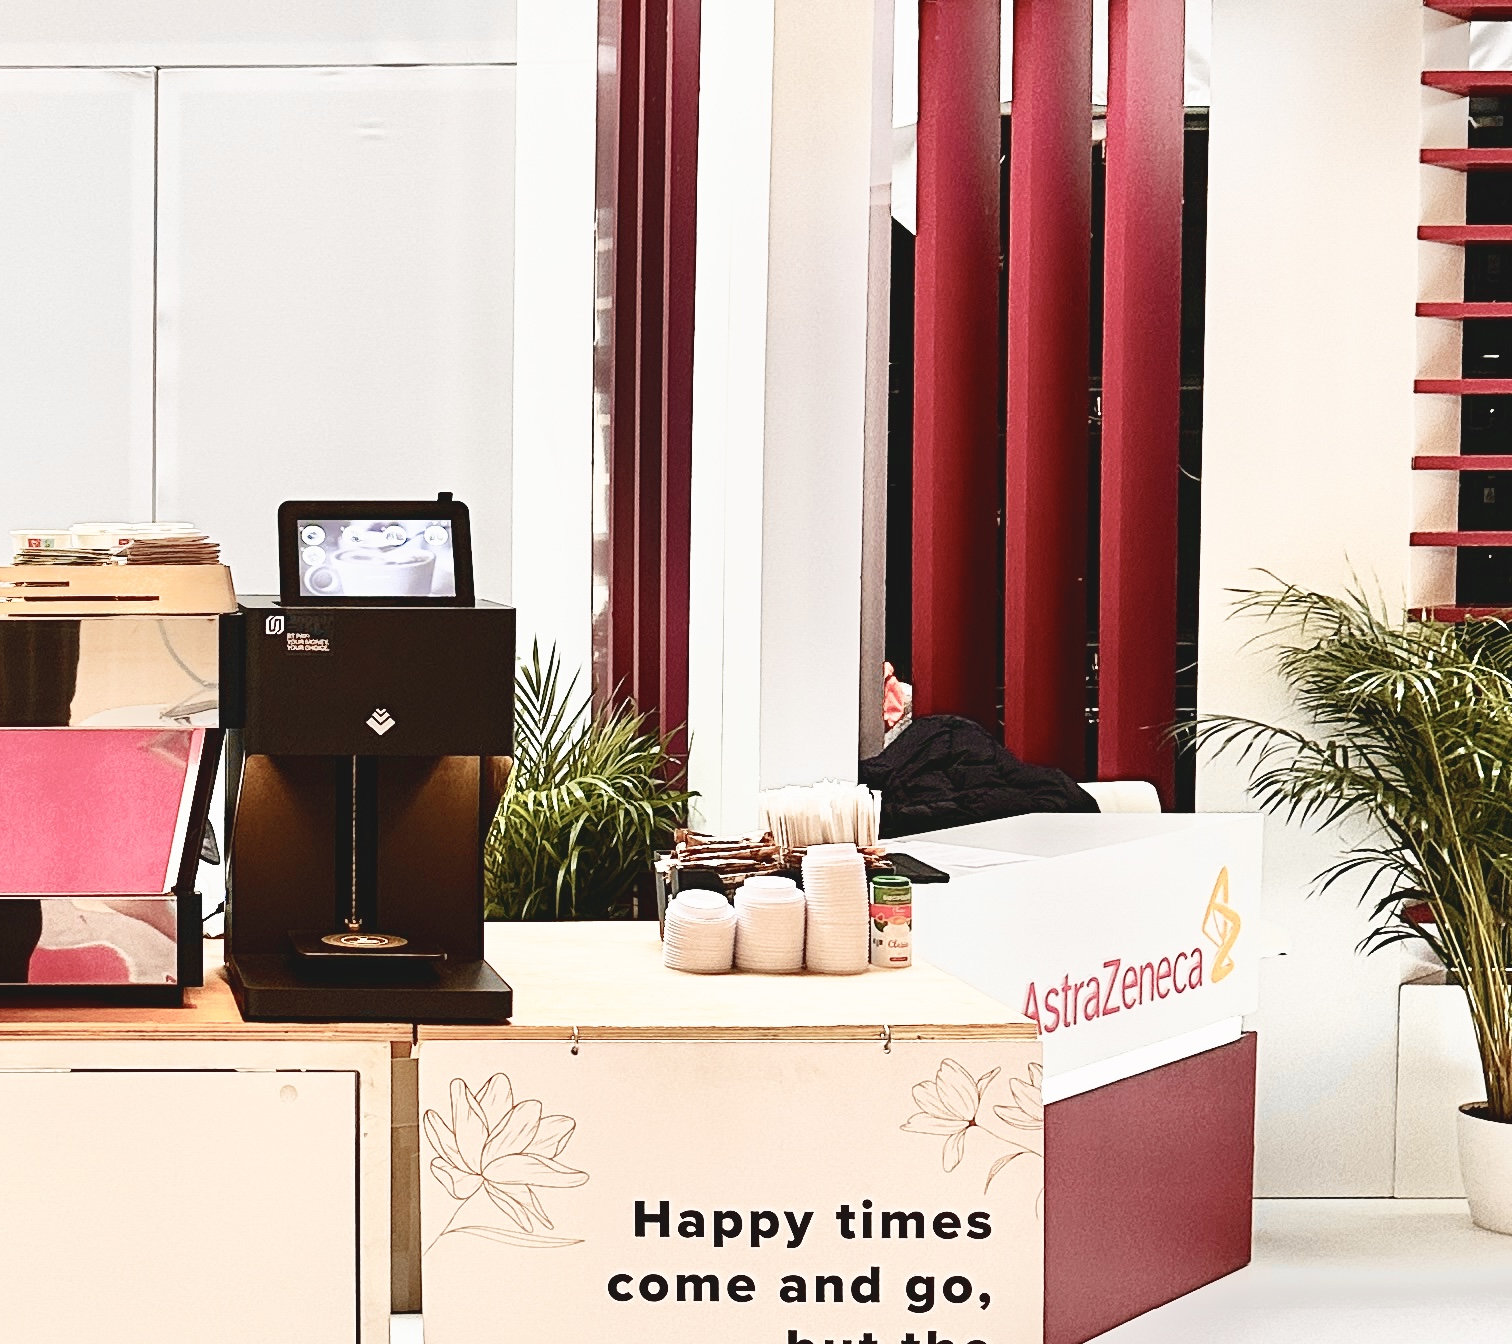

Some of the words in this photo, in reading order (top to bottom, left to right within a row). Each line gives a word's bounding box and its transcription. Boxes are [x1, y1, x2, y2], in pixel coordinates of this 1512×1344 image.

[1025, 947, 1203, 1035] AstraZeneca
[634, 1200, 815, 1249] Happy
[835, 1199, 992, 1240] times
[607, 1272, 756, 1303] come
[779, 1266, 881, 1304] and
[905, 1275, 992, 1314] go,
